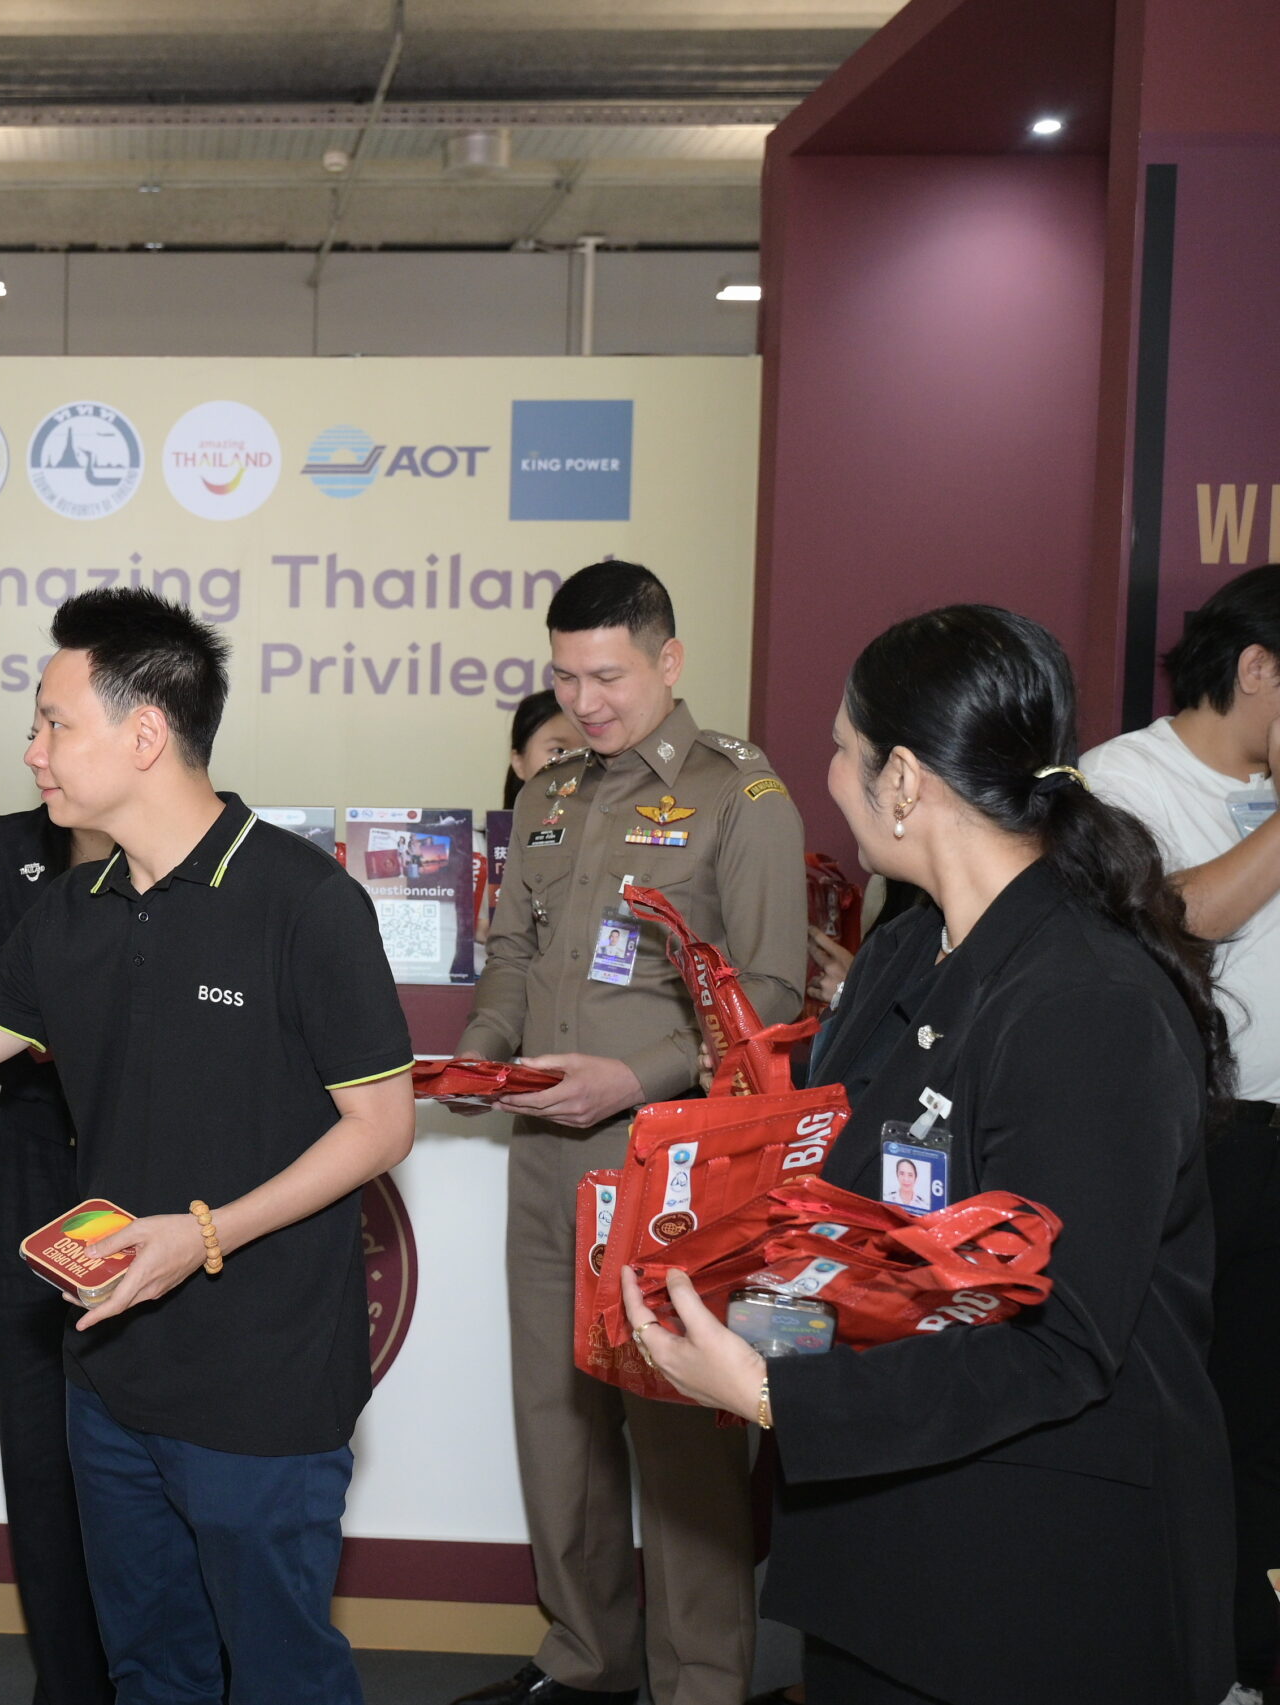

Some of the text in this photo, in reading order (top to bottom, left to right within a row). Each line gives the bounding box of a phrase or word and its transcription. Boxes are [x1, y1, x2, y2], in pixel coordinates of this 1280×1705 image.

[198, 438, 245, 452] amazing
[171, 452, 272, 468] THAILAND
[384, 445, 491, 478] AOT
[521, 457, 620, 472] KING POWER
[271, 552, 616, 611] Thailan
[198, 985, 244, 1007] BOSS
[782, 1111, 835, 1170] BAG
[931, 1179, 944, 1197] 6
[42, 1246, 89, 1278] THAI DRIED
[53, 1237, 106, 1271] MANGO
